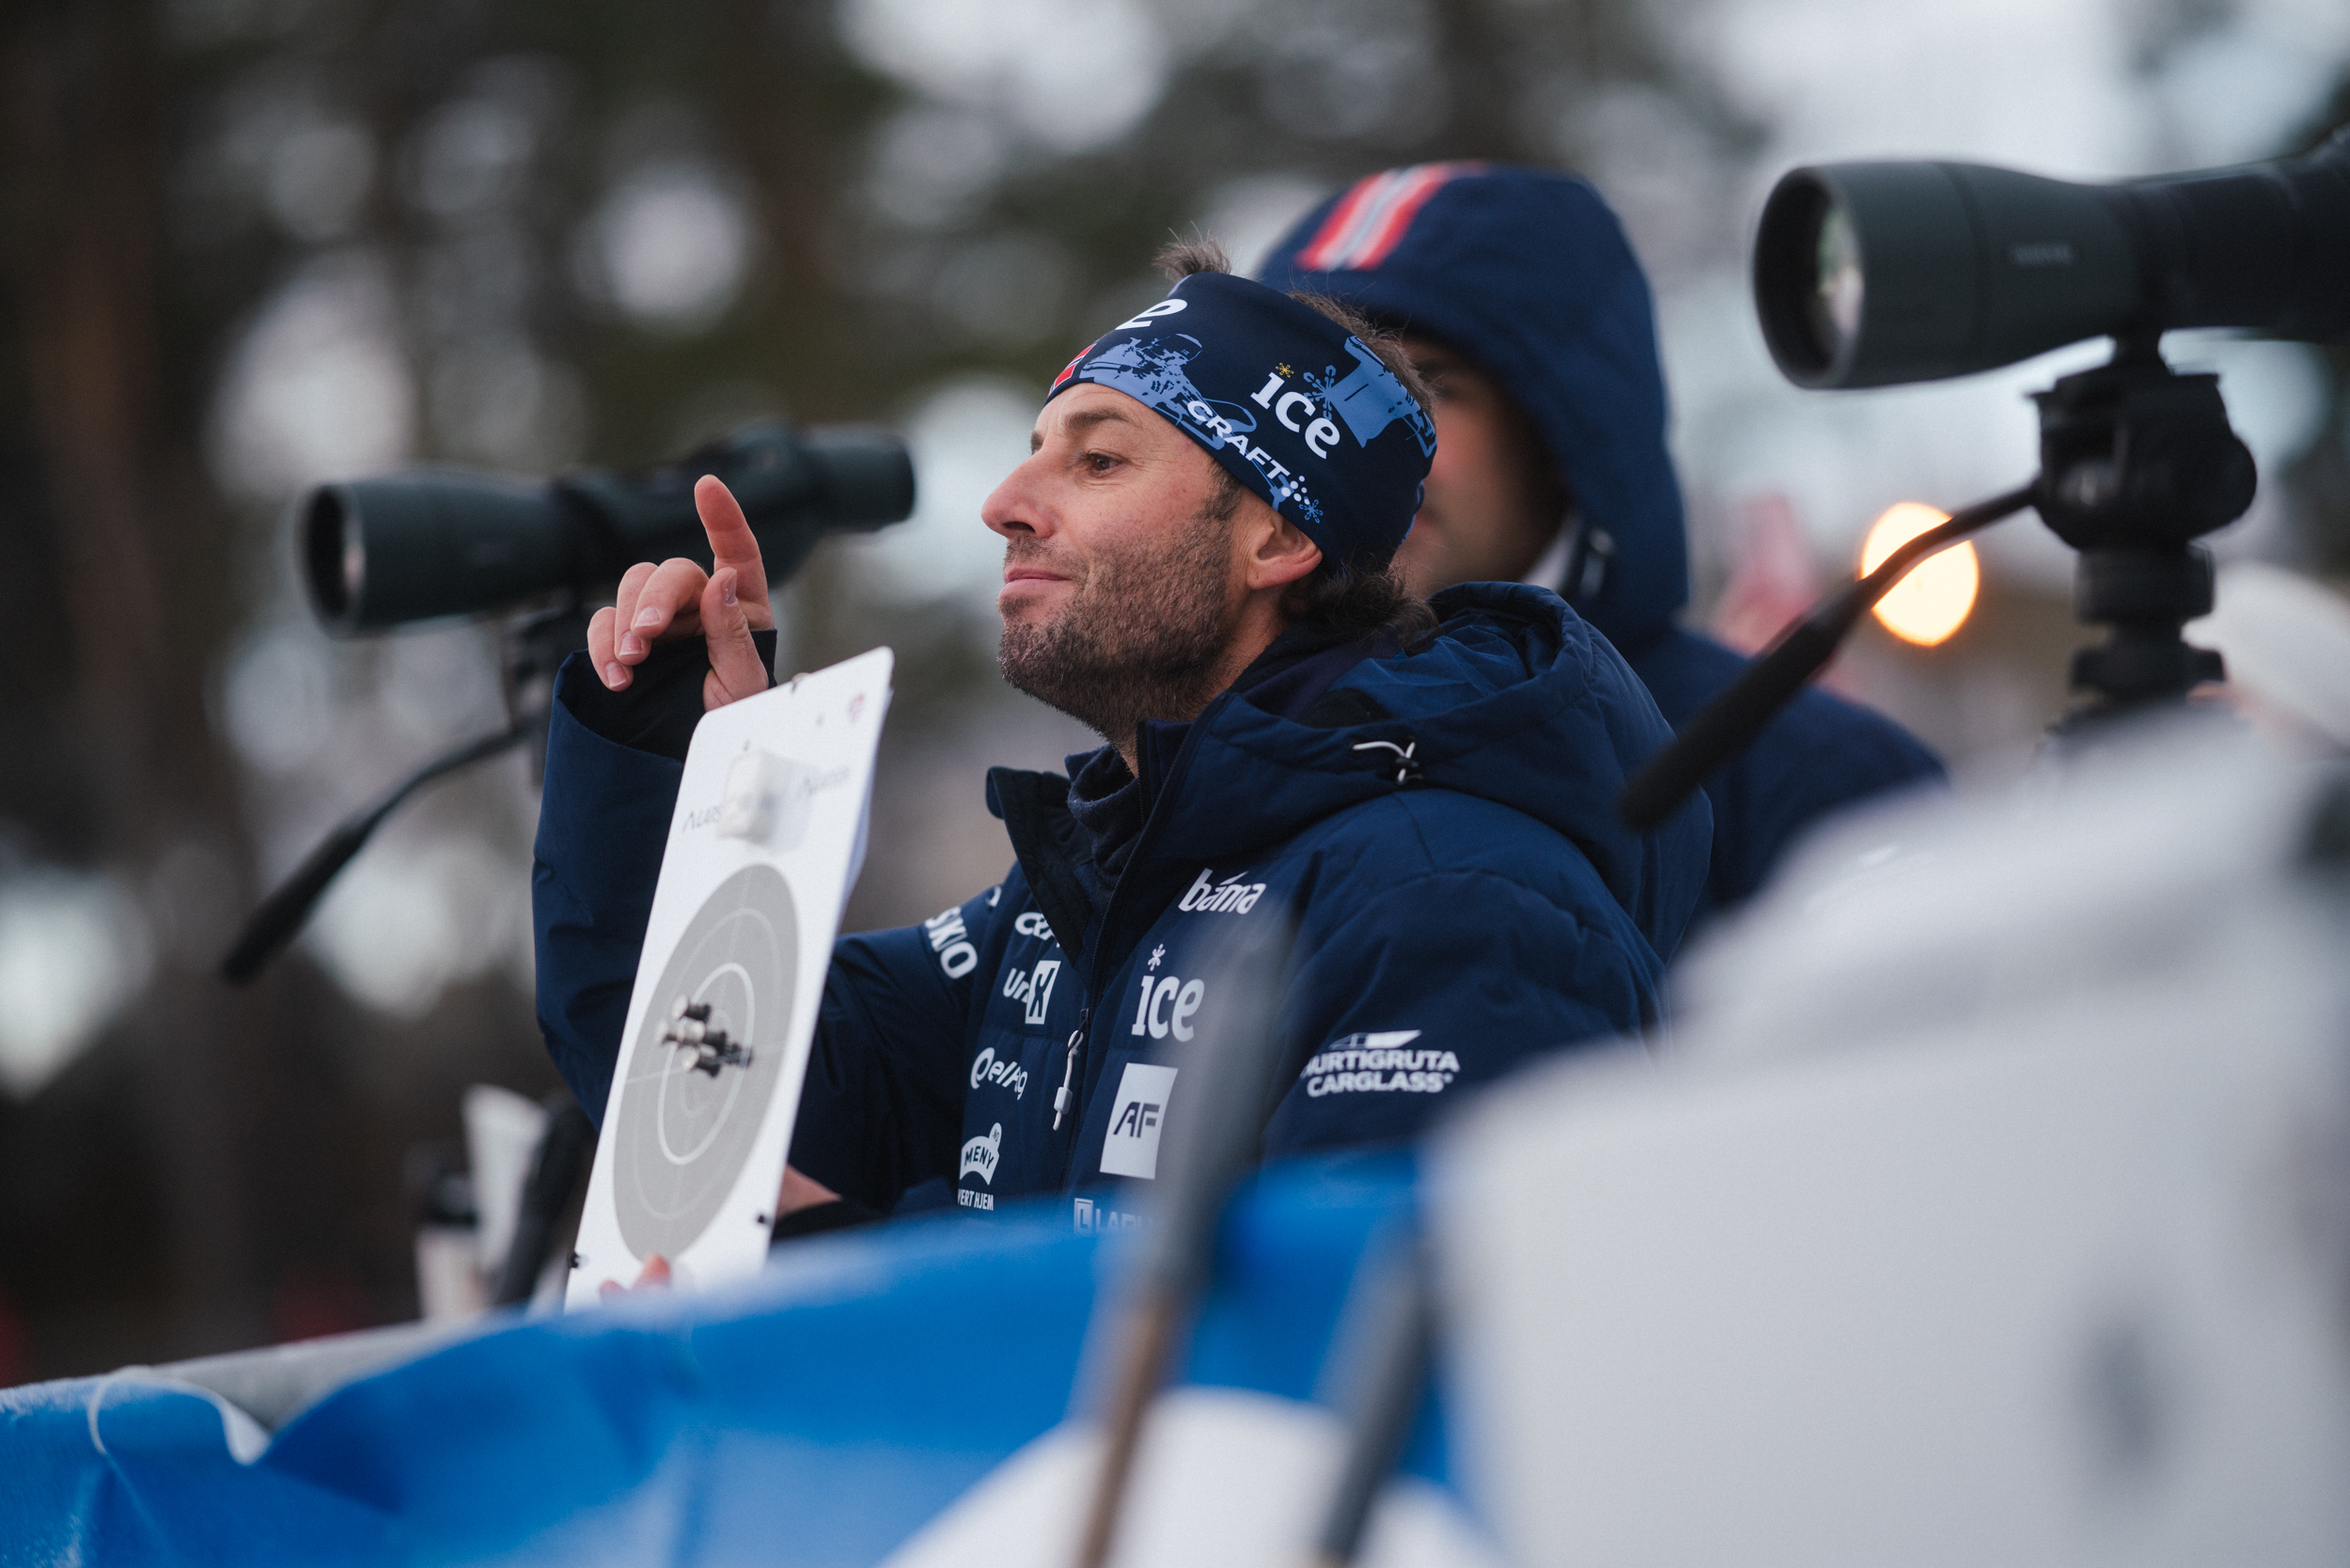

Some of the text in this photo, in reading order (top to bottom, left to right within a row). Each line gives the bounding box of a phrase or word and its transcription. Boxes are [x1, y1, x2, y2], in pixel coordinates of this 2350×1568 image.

[1186, 400, 1292, 479] CRAFT
[1250, 371, 1340, 460] ice
[1131, 974, 1205, 1043] ice
[1113, 1101, 1161, 1138] AF
[964, 1145, 995, 1169] MENY
[974, 1191, 995, 1212] HJEM
